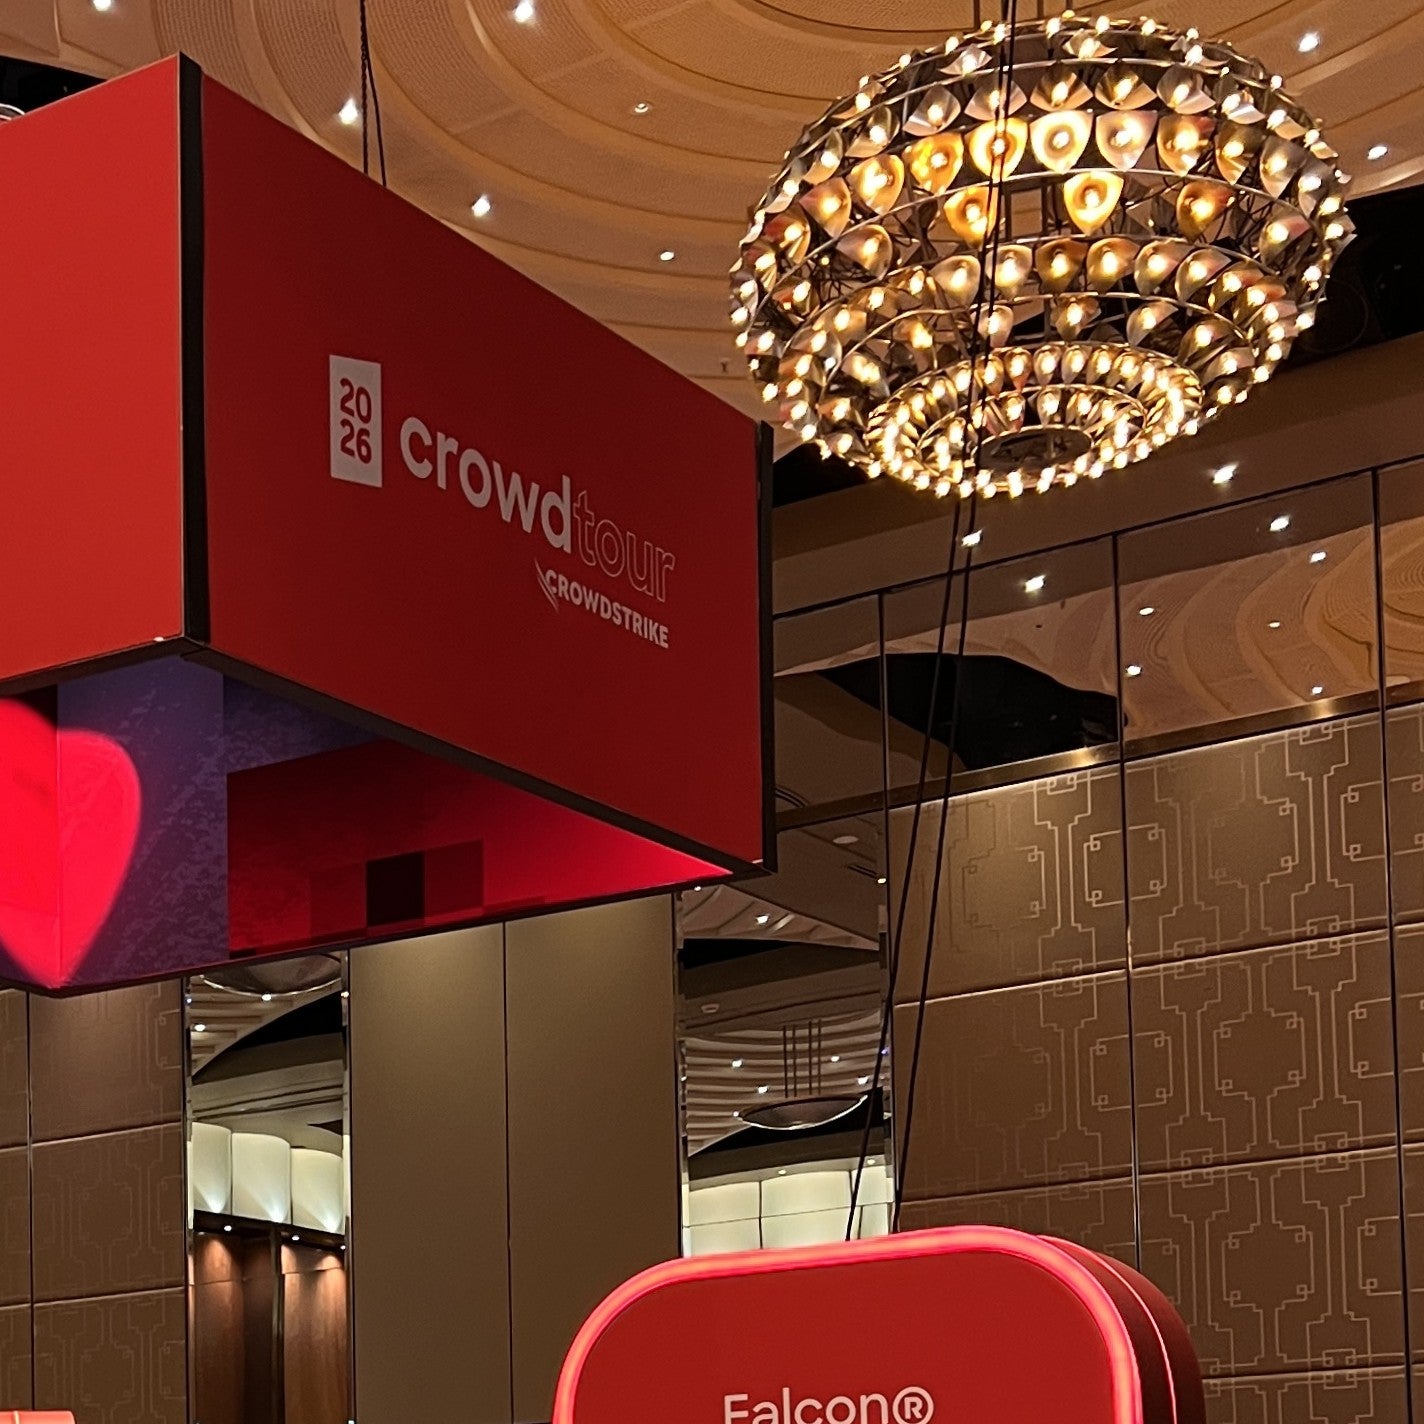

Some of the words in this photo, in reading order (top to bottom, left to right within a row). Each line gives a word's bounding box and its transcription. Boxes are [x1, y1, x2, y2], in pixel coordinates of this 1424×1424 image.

[340, 378, 372, 424] 20
[340, 418, 372, 464] 26
[400, 417, 675, 602] crowdtour
[544, 569, 669, 649] CROWDSTRIKE
